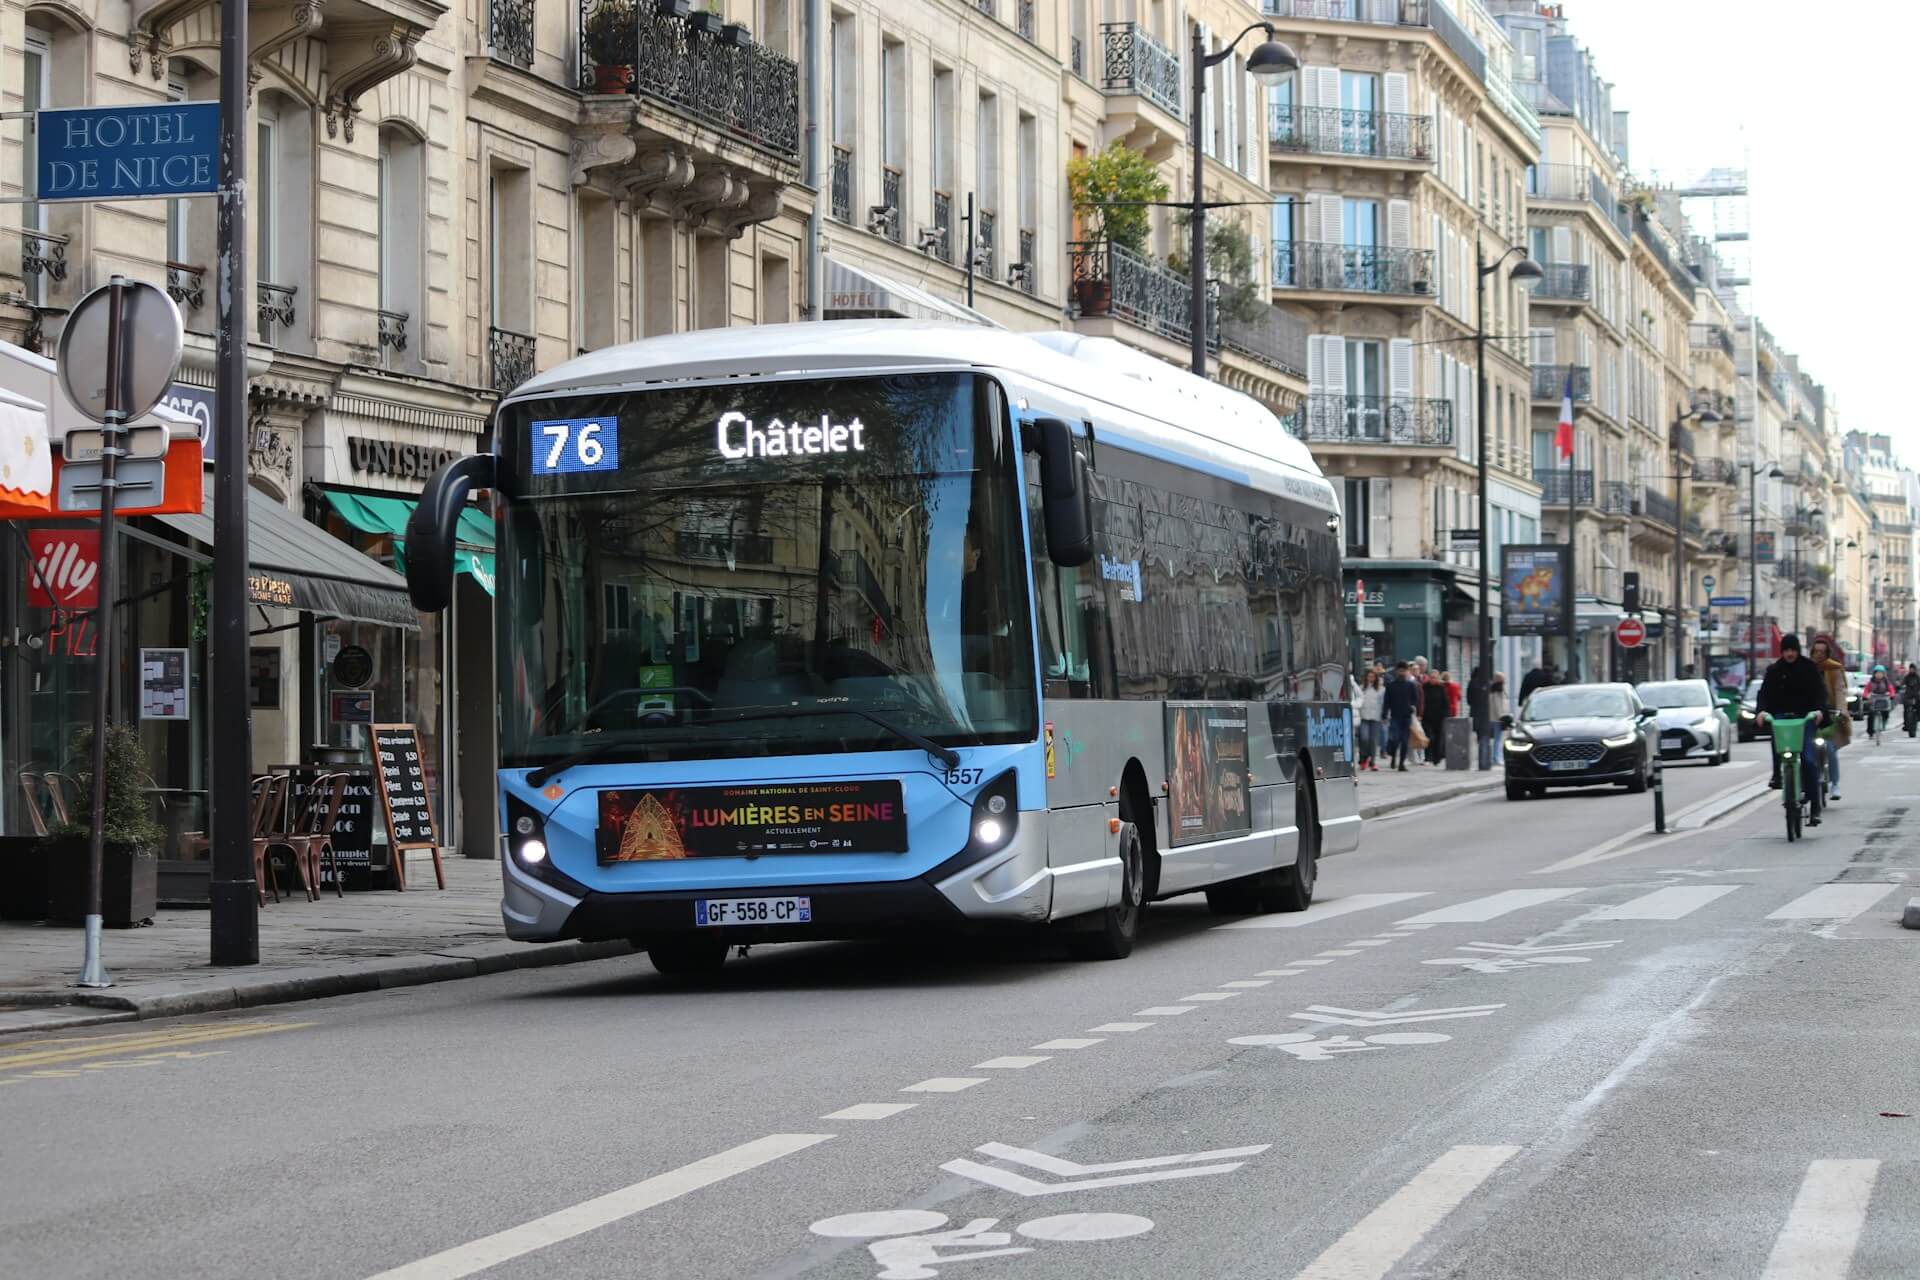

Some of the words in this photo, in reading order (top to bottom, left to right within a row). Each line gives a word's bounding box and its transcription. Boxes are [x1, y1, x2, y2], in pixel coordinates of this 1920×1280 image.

[63, 113, 195, 149] HOTEL
[48, 159, 99, 192] DE
[112, 154, 211, 189] NICE
[832, 291, 874, 306] HOTEL
[543, 423, 603, 468] 76
[717, 411, 865, 459] Châtelet
[349, 437, 463, 479] UNISHO
[33, 541, 98, 600] illy
[379, 751, 395, 761] Pizza
[942, 768, 984, 785] 1557
[343, 784, 372, 796] box
[760, 787, 797, 795] NATIONAL
[810, 785, 860, 793] SAINT-CLOUD
[692, 803, 800, 827] LUMIÈRES
[804, 808, 825, 821] EN
[829, 802, 894, 822] SEINE
[765, 827, 821, 835] ACTUELLEMENT
[709, 901, 796, 921] GF-558-CP
